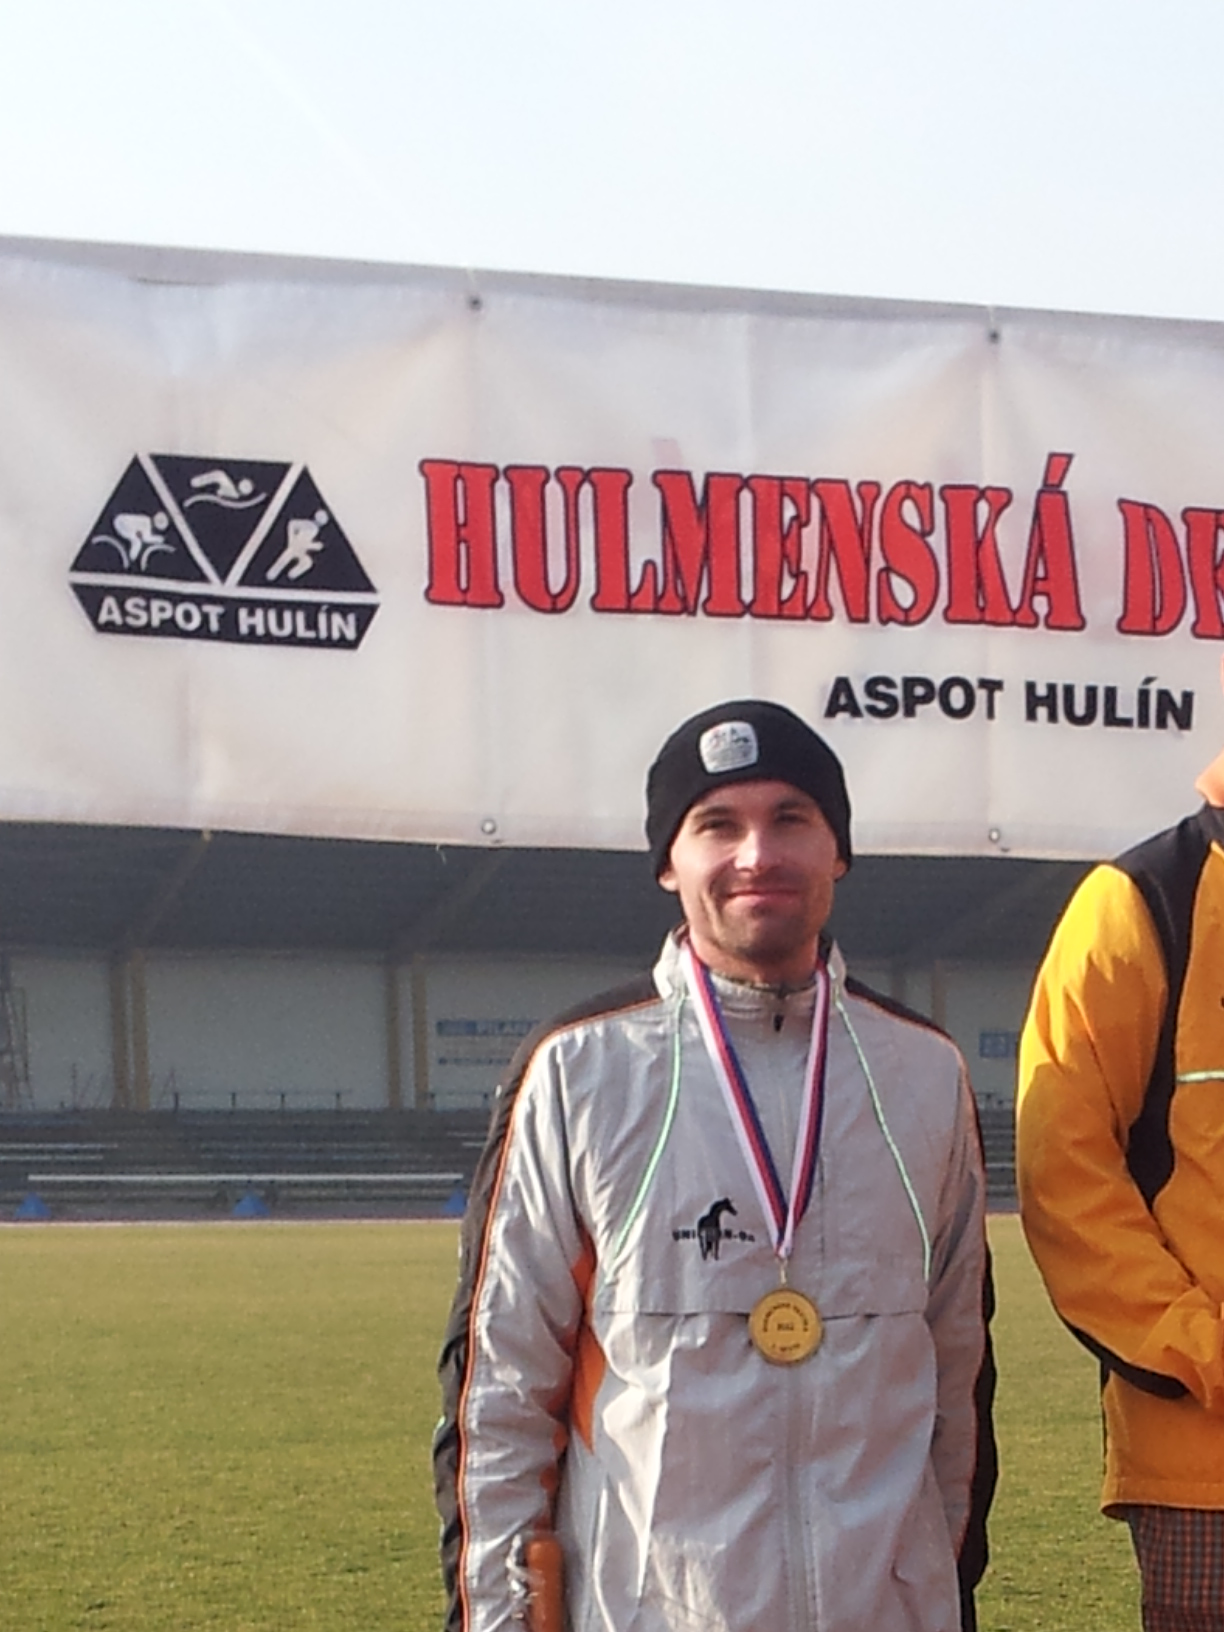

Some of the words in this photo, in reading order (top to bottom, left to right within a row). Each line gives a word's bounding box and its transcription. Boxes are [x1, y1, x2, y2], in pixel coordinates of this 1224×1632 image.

[419, 452, 1086, 631] HULMENSKÁ
[98, 595, 226, 633] ASPOT
[238, 604, 358, 641] HULÍN
[824, 675, 1005, 721] ASPOT
[1024, 676, 1195, 731] HULÍN
